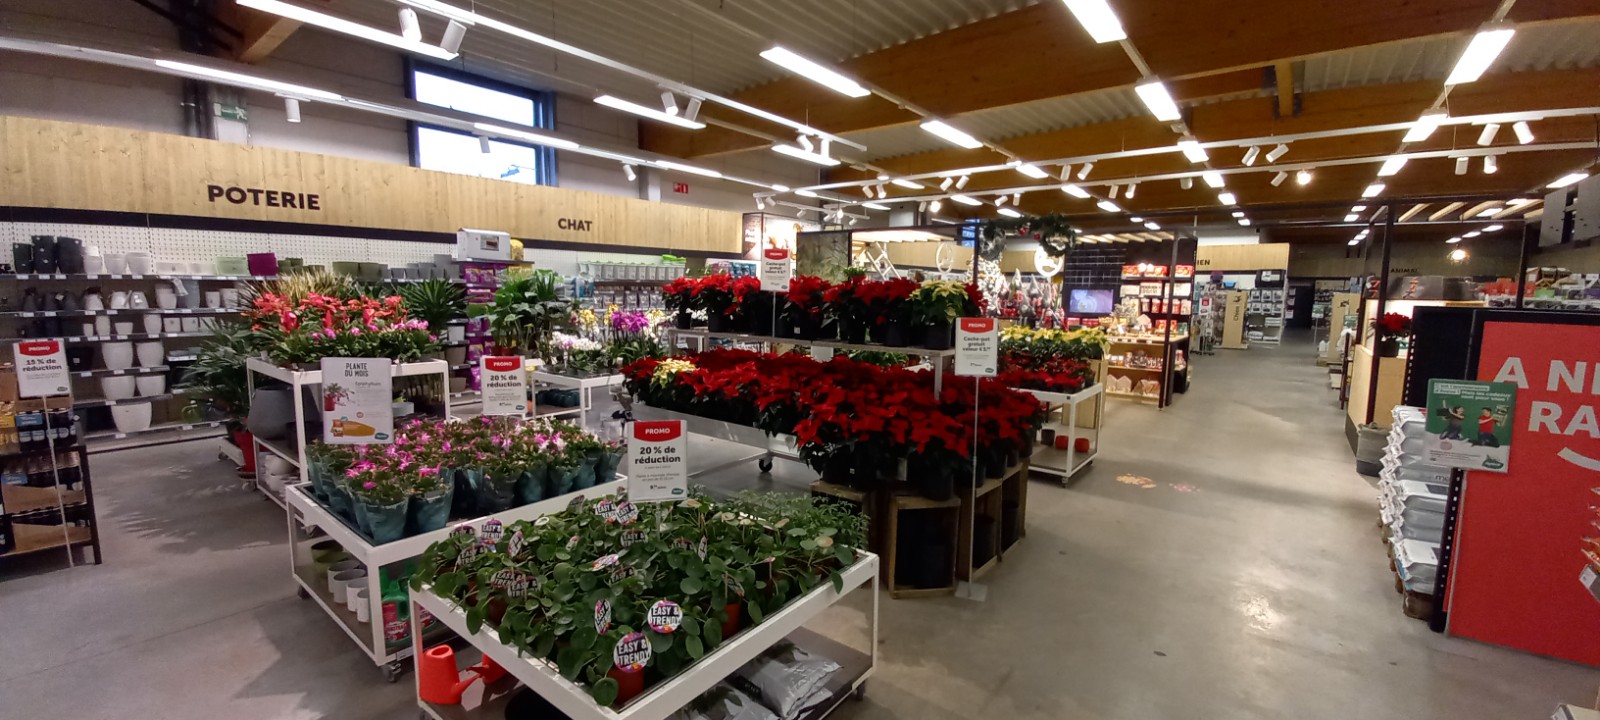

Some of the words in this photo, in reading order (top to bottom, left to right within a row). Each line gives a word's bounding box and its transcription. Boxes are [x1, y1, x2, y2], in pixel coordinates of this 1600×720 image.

[207, 184, 321, 211] POTERIE
[557, 217, 593, 232] CHAT
[345, 362, 368, 370] PLANTE
[344, 369, 353, 377] DU
[354, 369, 369, 377] MOIS
[1493, 356, 1529, 389] A
[653, 446, 662, 454] %
[635, 456, 680, 464] réduction
[598, 505, 611, 514] EASY
[618, 506, 629, 516] EASY
[611, 571, 626, 583] EASY
[652, 605, 670, 616] EASY
[674, 606, 680, 616] &
[653, 616, 681, 626] TRENDY
[618, 641, 639, 655] EASY
[641, 638, 649, 650] &
[618, 650, 651, 666] TRENDY
